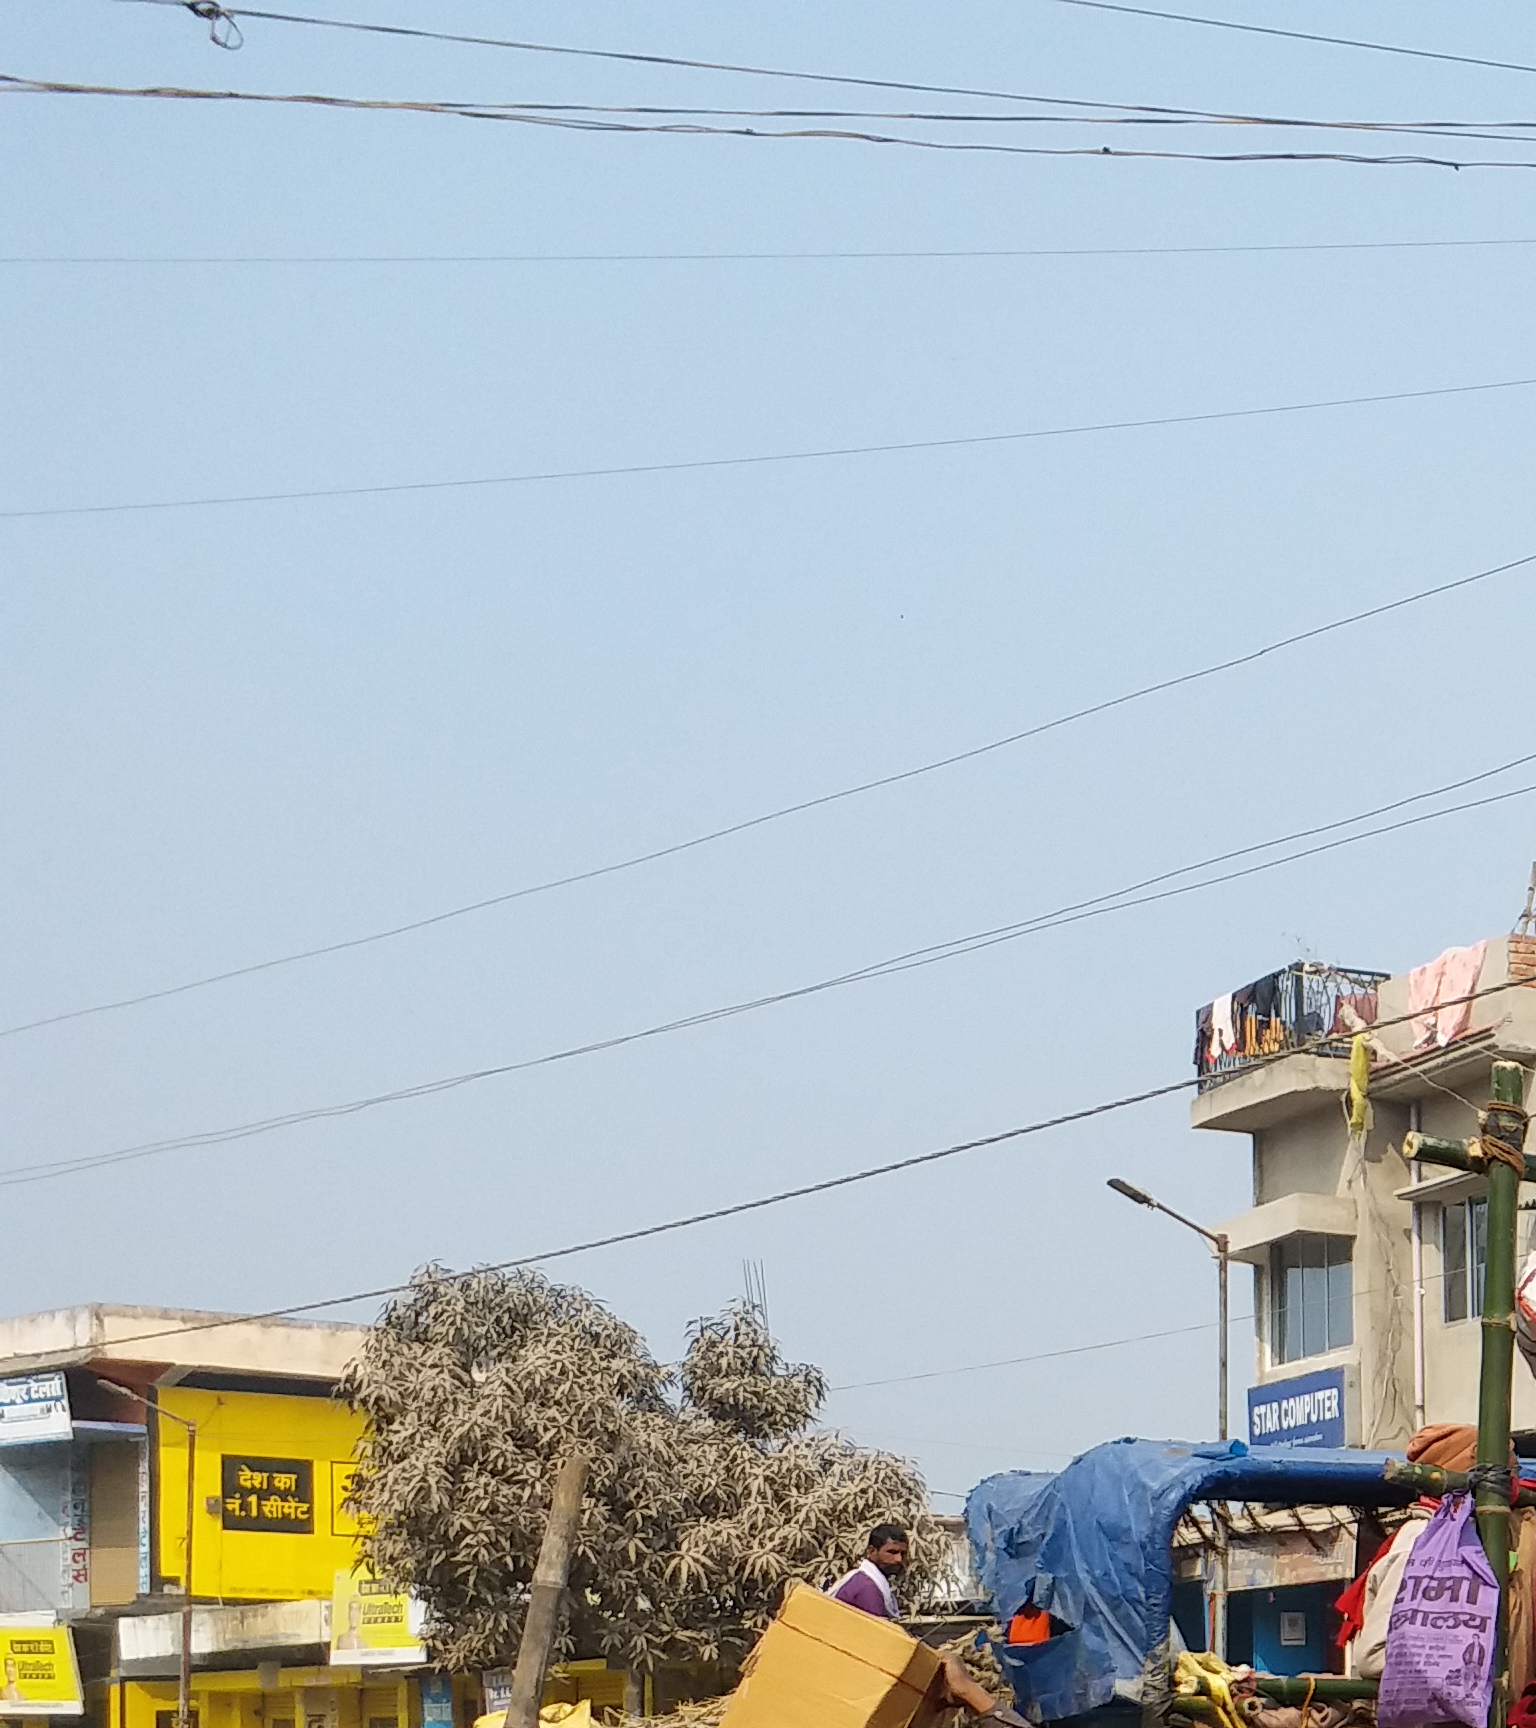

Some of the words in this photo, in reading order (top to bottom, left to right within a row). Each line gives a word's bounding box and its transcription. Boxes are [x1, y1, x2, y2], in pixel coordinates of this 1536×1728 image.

[1253, 1400, 1281, 1437] STAR
[1280, 1387, 1340, 1431] COMPUTER
[238, 1465, 269, 1490] देश
[272, 1473, 298, 1491] का
[261, 1495, 310, 1520] सीमेंट
